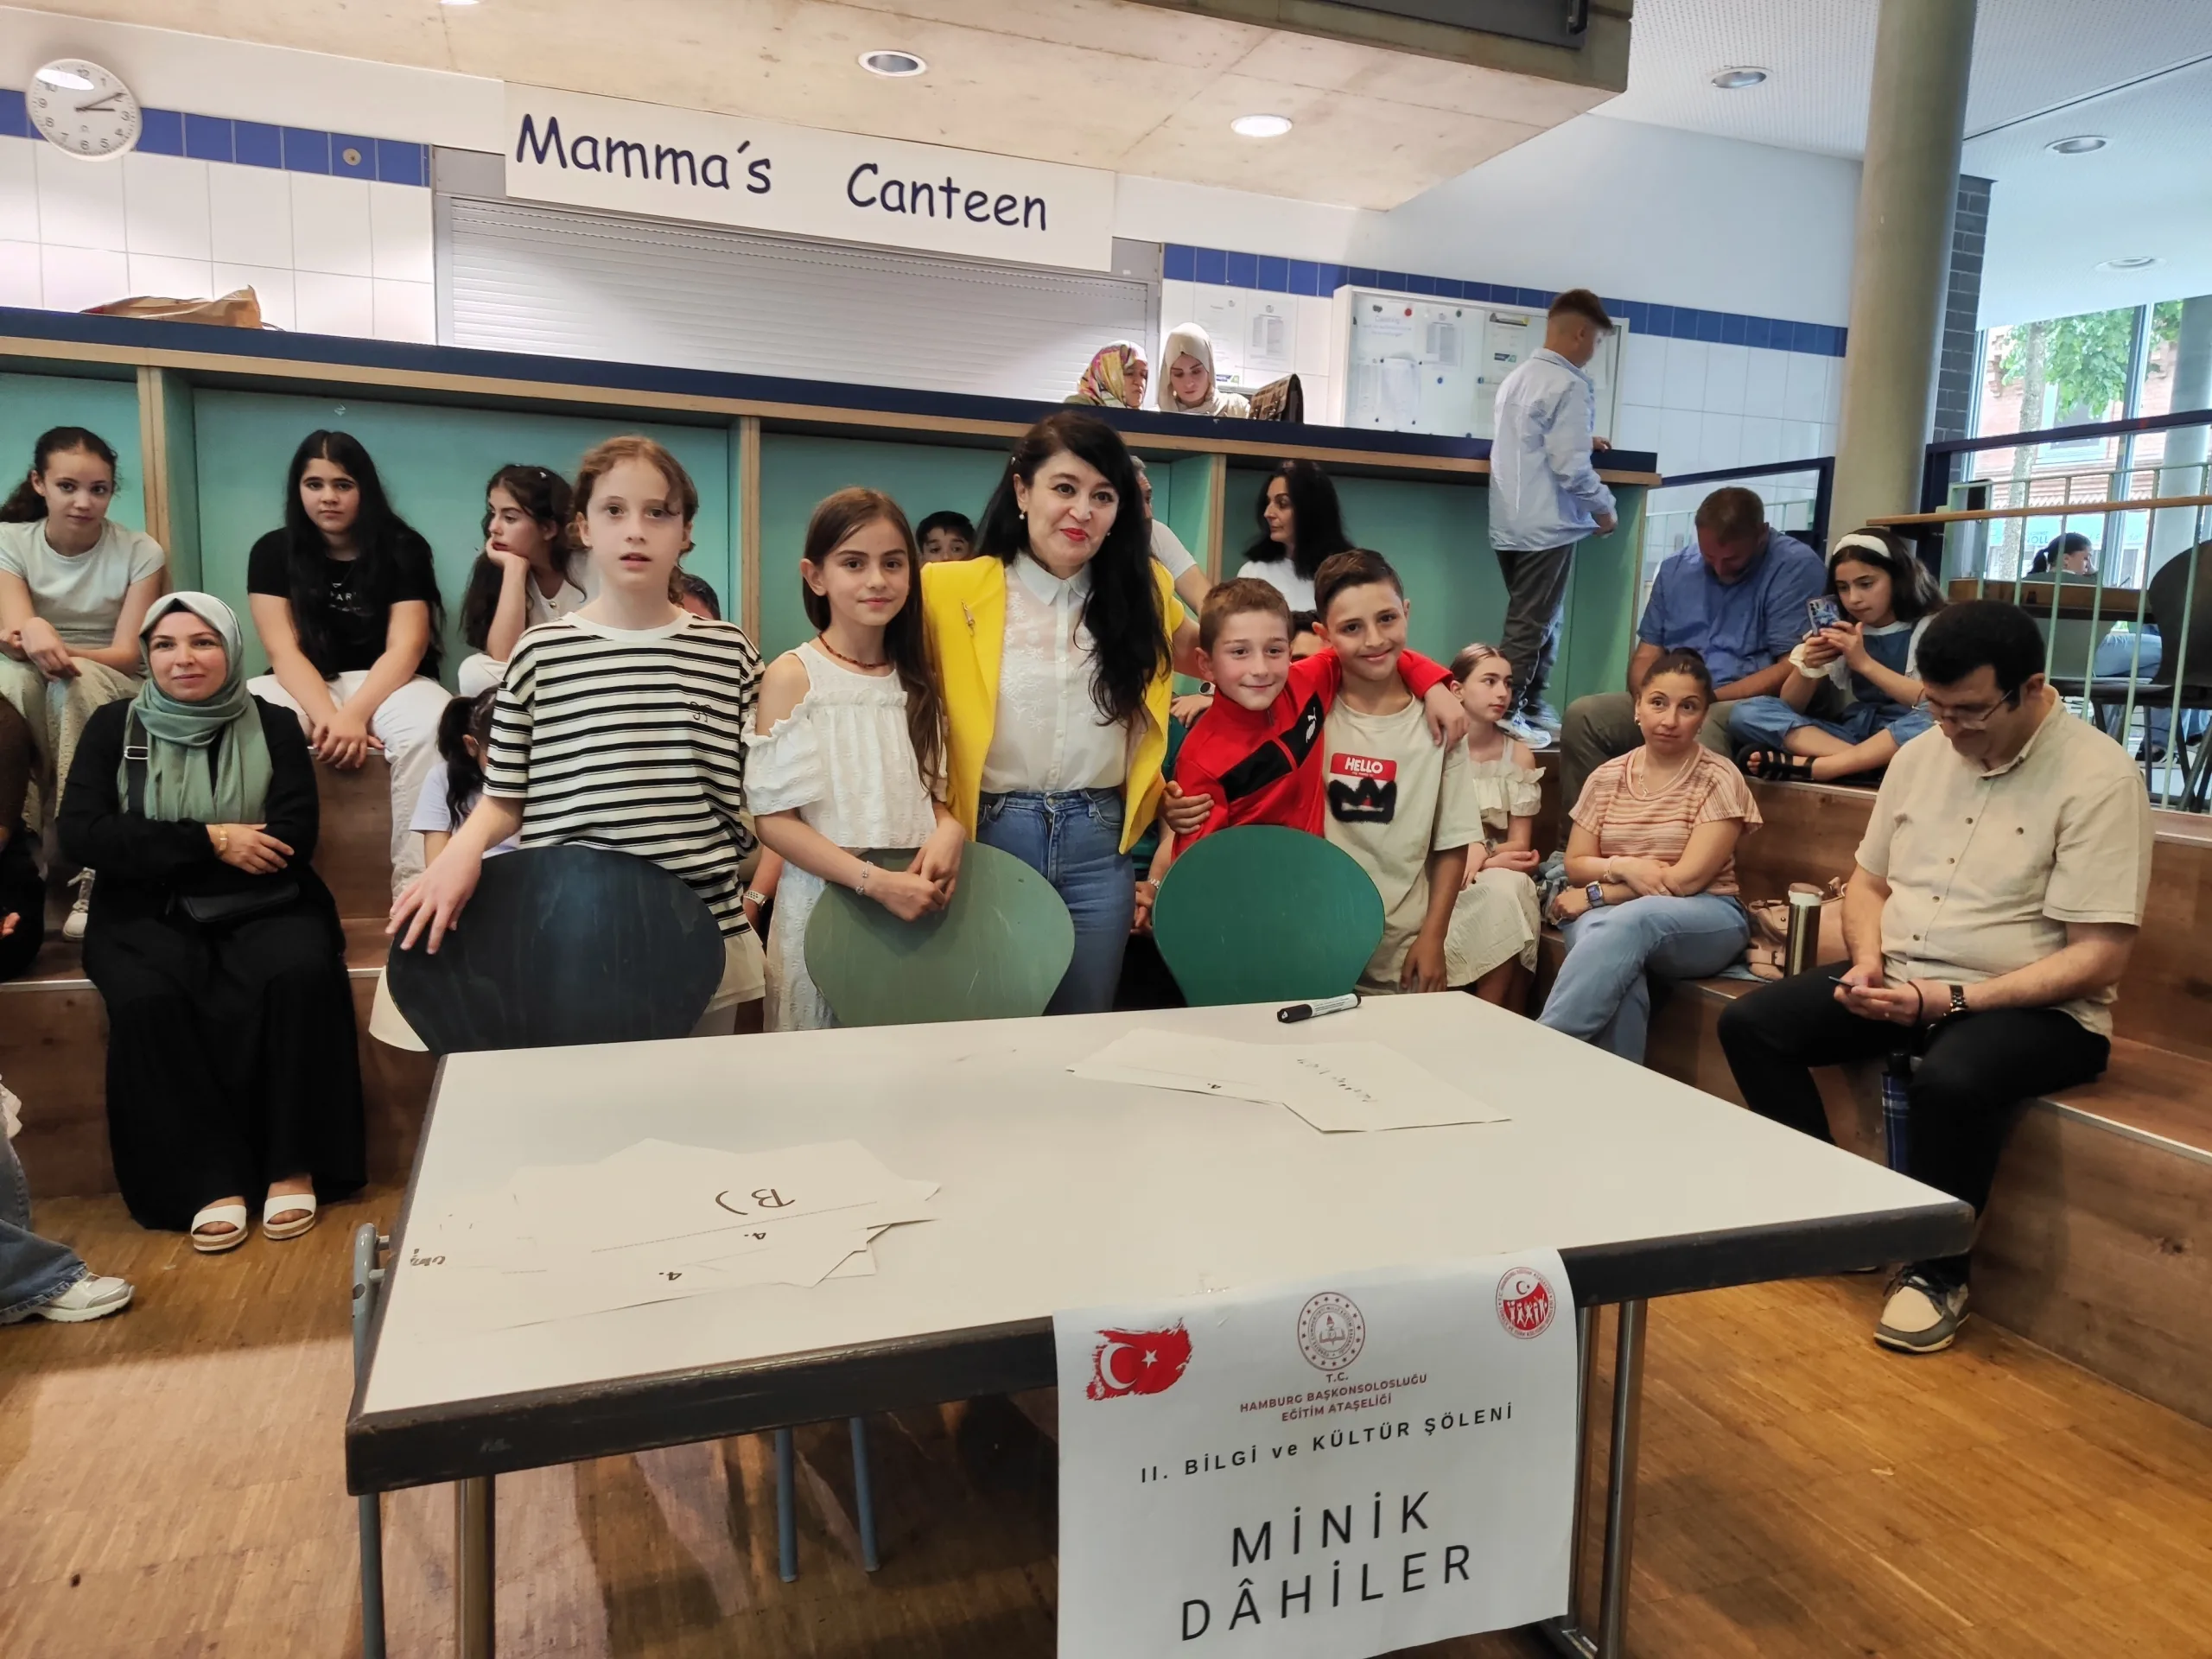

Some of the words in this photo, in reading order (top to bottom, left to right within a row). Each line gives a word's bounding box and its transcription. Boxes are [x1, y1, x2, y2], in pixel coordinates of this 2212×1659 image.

[38, 98, 48, 109] 9
[45, 117, 54, 128] 8
[120, 110, 131, 121] 3
[79, 139, 90, 150] 6
[847, 162, 1046, 232] Canteen
[1344, 757, 1383, 774] HELLO
[1325, 1372, 1349, 1383] T.C.
[1240, 1395, 1303, 1413] HAMBURG
[1306, 1374, 1427, 1402] BAŞKONSOLOSLUĞU
[1281, 1405, 1325, 1422] EĞİTİM
[1328, 1393, 1392, 1414] ATAŞELİĞİ
[1185, 1445, 1257, 1475] BİLGİ
[1272, 1443, 1298, 1459] ve
[1313, 1421, 1410, 1452] KÜLTÜR
[1424, 1402, 1514, 1436] ŞÖLENİ
[1232, 1491, 1429, 1567] MİNİK
[1182, 1544, 1471, 1642] DÂHİLER
